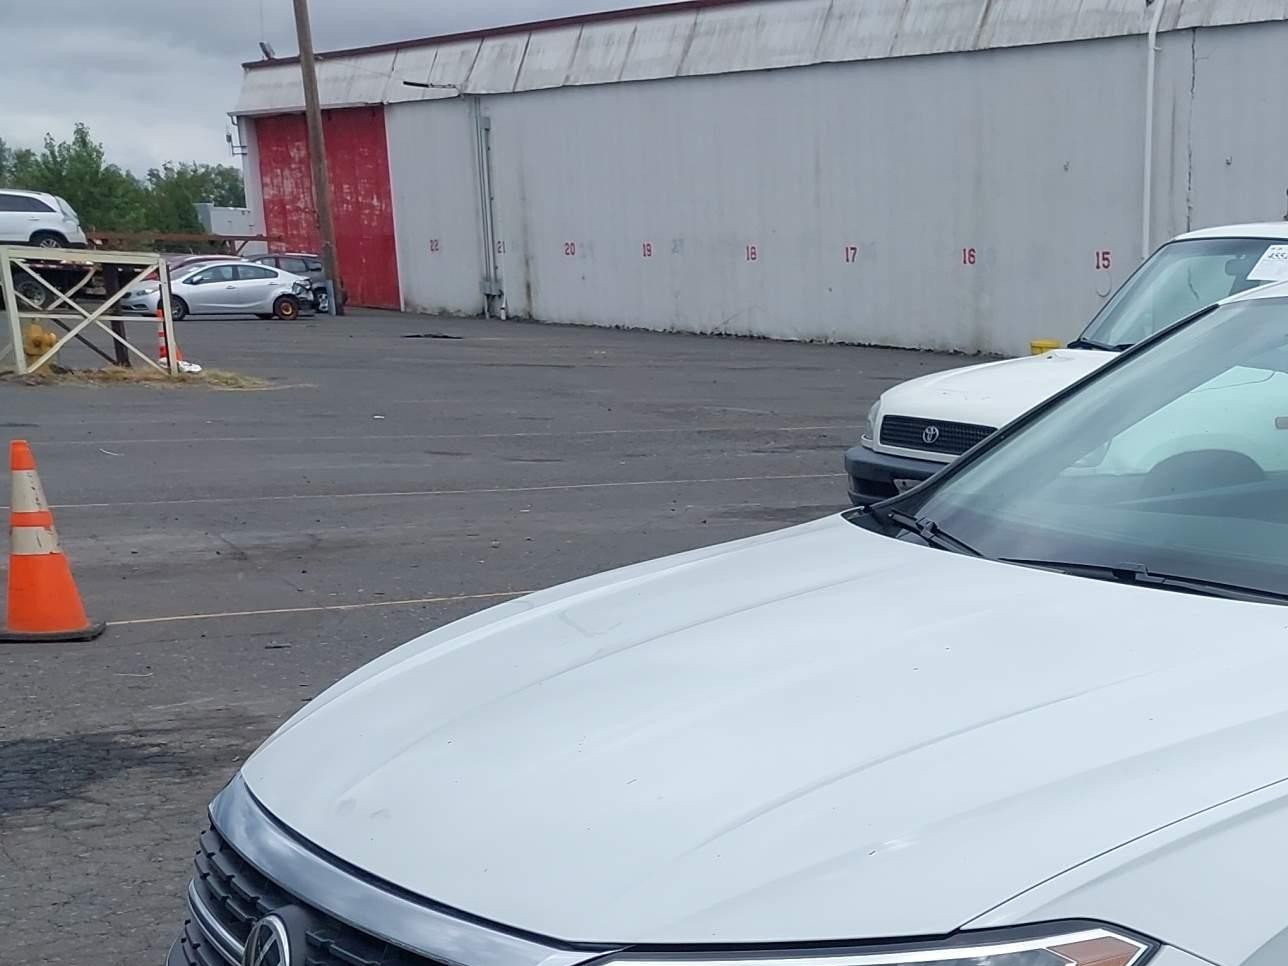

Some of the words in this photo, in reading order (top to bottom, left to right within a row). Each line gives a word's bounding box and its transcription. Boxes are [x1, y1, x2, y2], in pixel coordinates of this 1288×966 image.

[429, 239, 440, 252] 22
[496, 240, 506, 254] 21
[564, 242, 576, 256] 20
[641, 243, 652, 257] 19
[745, 246, 757, 261] 18
[844, 246, 857, 263] 17
[962, 248, 976, 265] 16
[1095, 251, 1111, 269] 15
